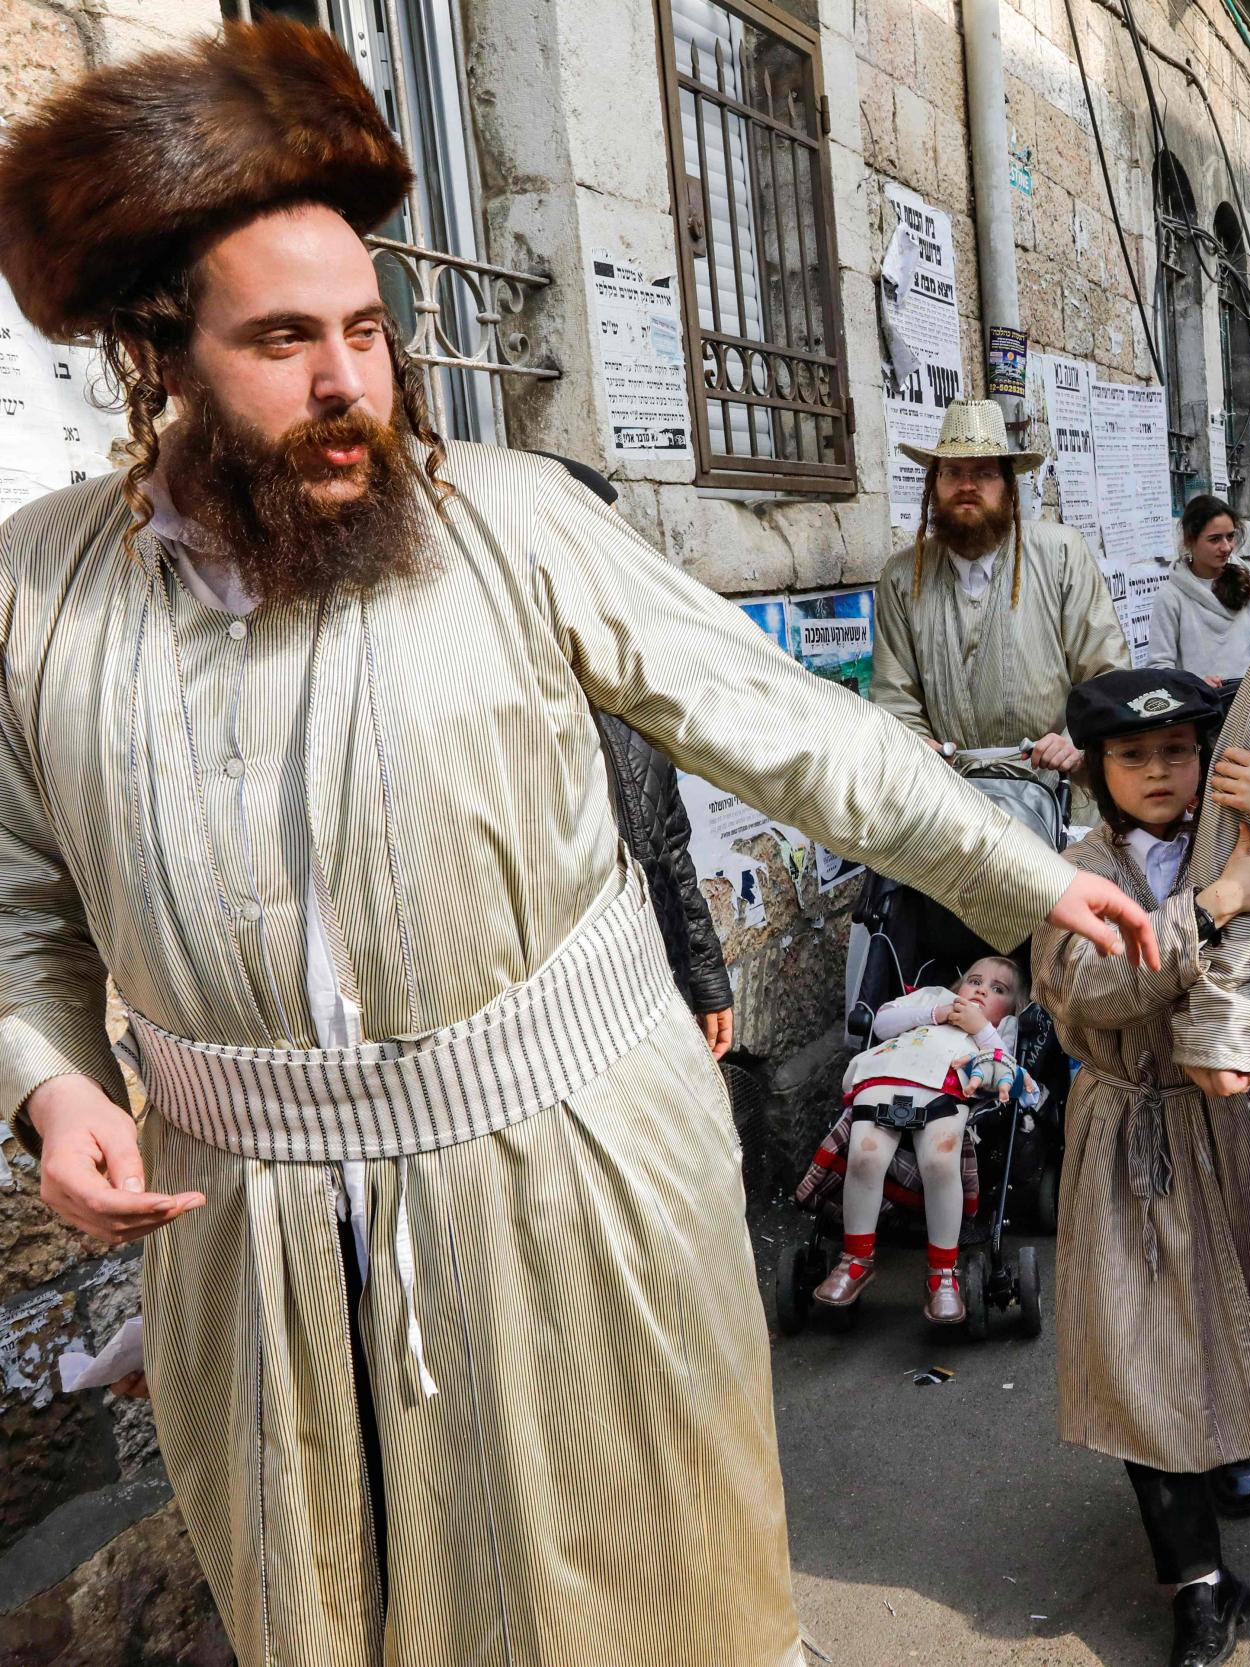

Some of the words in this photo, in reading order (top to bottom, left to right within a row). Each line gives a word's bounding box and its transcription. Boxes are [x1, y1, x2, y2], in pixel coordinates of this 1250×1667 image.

[595, 280, 617, 298] בקלפי
[639, 290, 655, 303] פתק
[601, 320, 619, 335] ש"ס
[635, 432, 650, 443] מדבר
